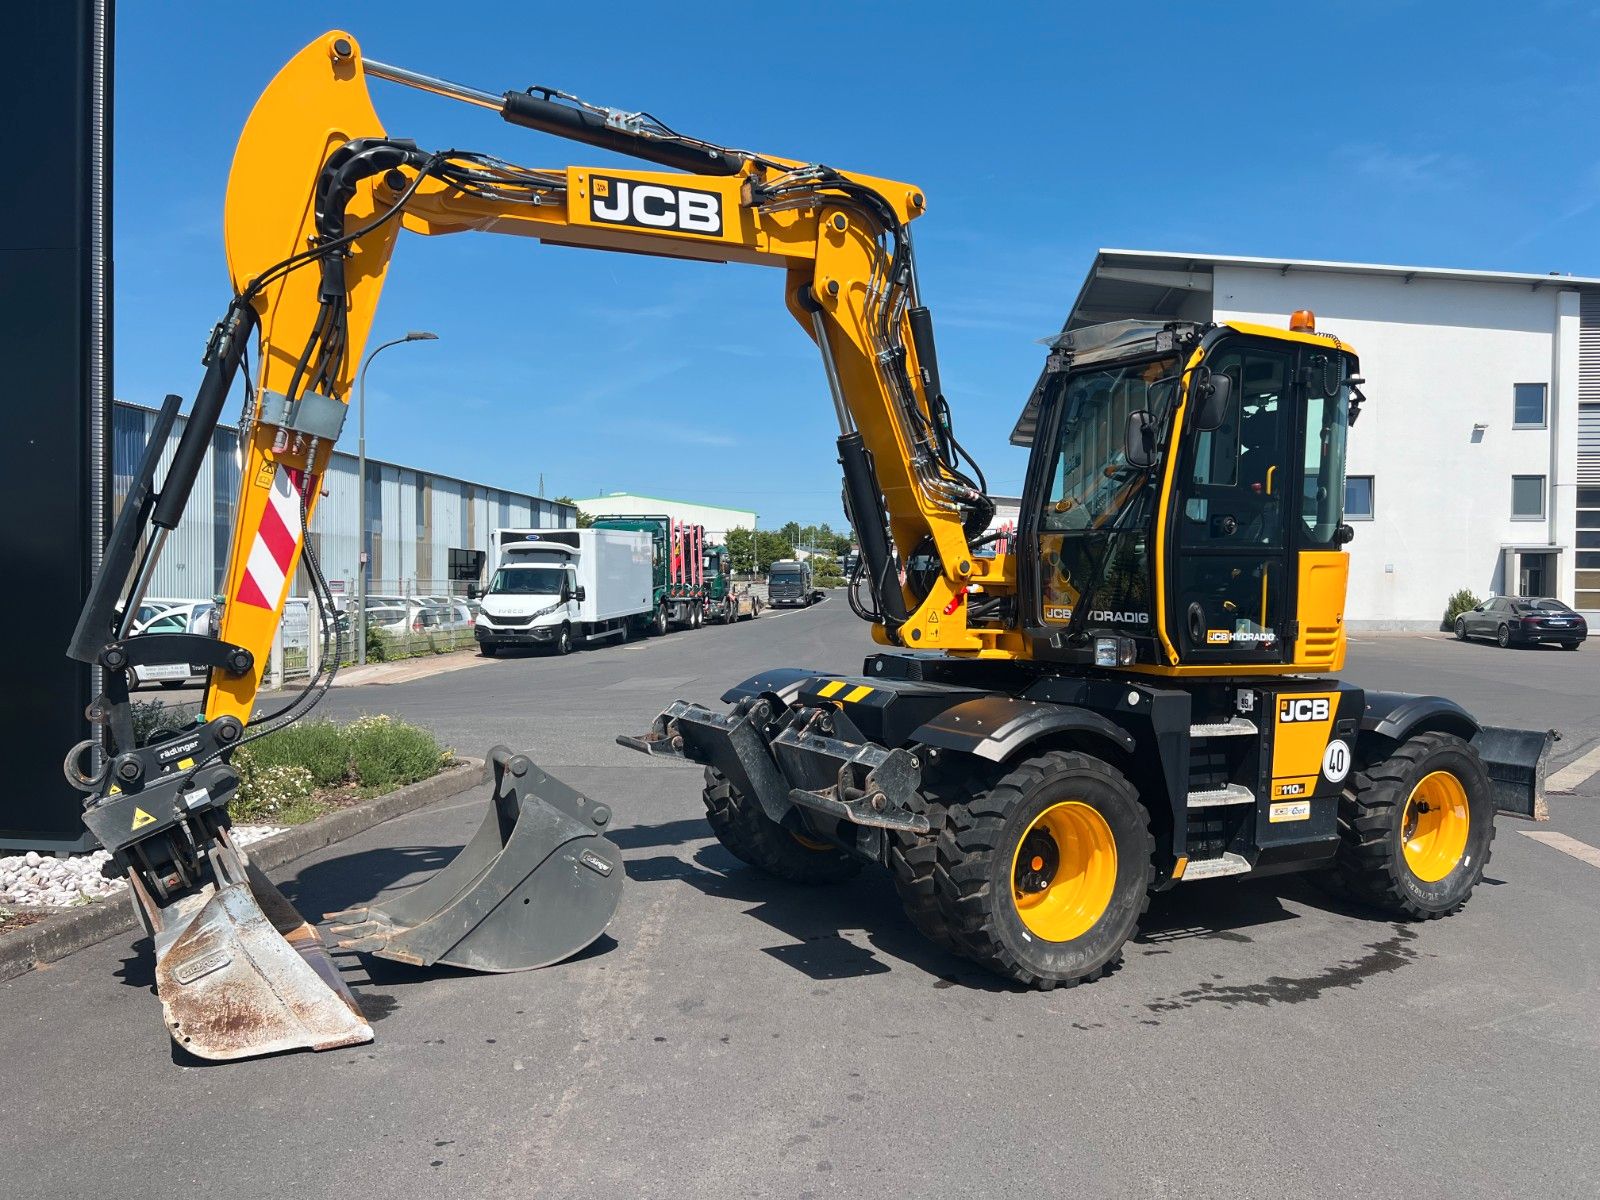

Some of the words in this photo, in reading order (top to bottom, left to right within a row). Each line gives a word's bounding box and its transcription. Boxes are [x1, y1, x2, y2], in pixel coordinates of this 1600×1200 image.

[593, 182, 720, 232] JCB
[1046, 608, 1072, 619] JCB
[1087, 610, 1149, 624] YDRADIG
[1229, 633, 1276, 641] HYDRADIG
[1280, 699, 1329, 721] JCB
[160, 741, 199, 759] rädlinger
[1329, 748, 1344, 773] 40
